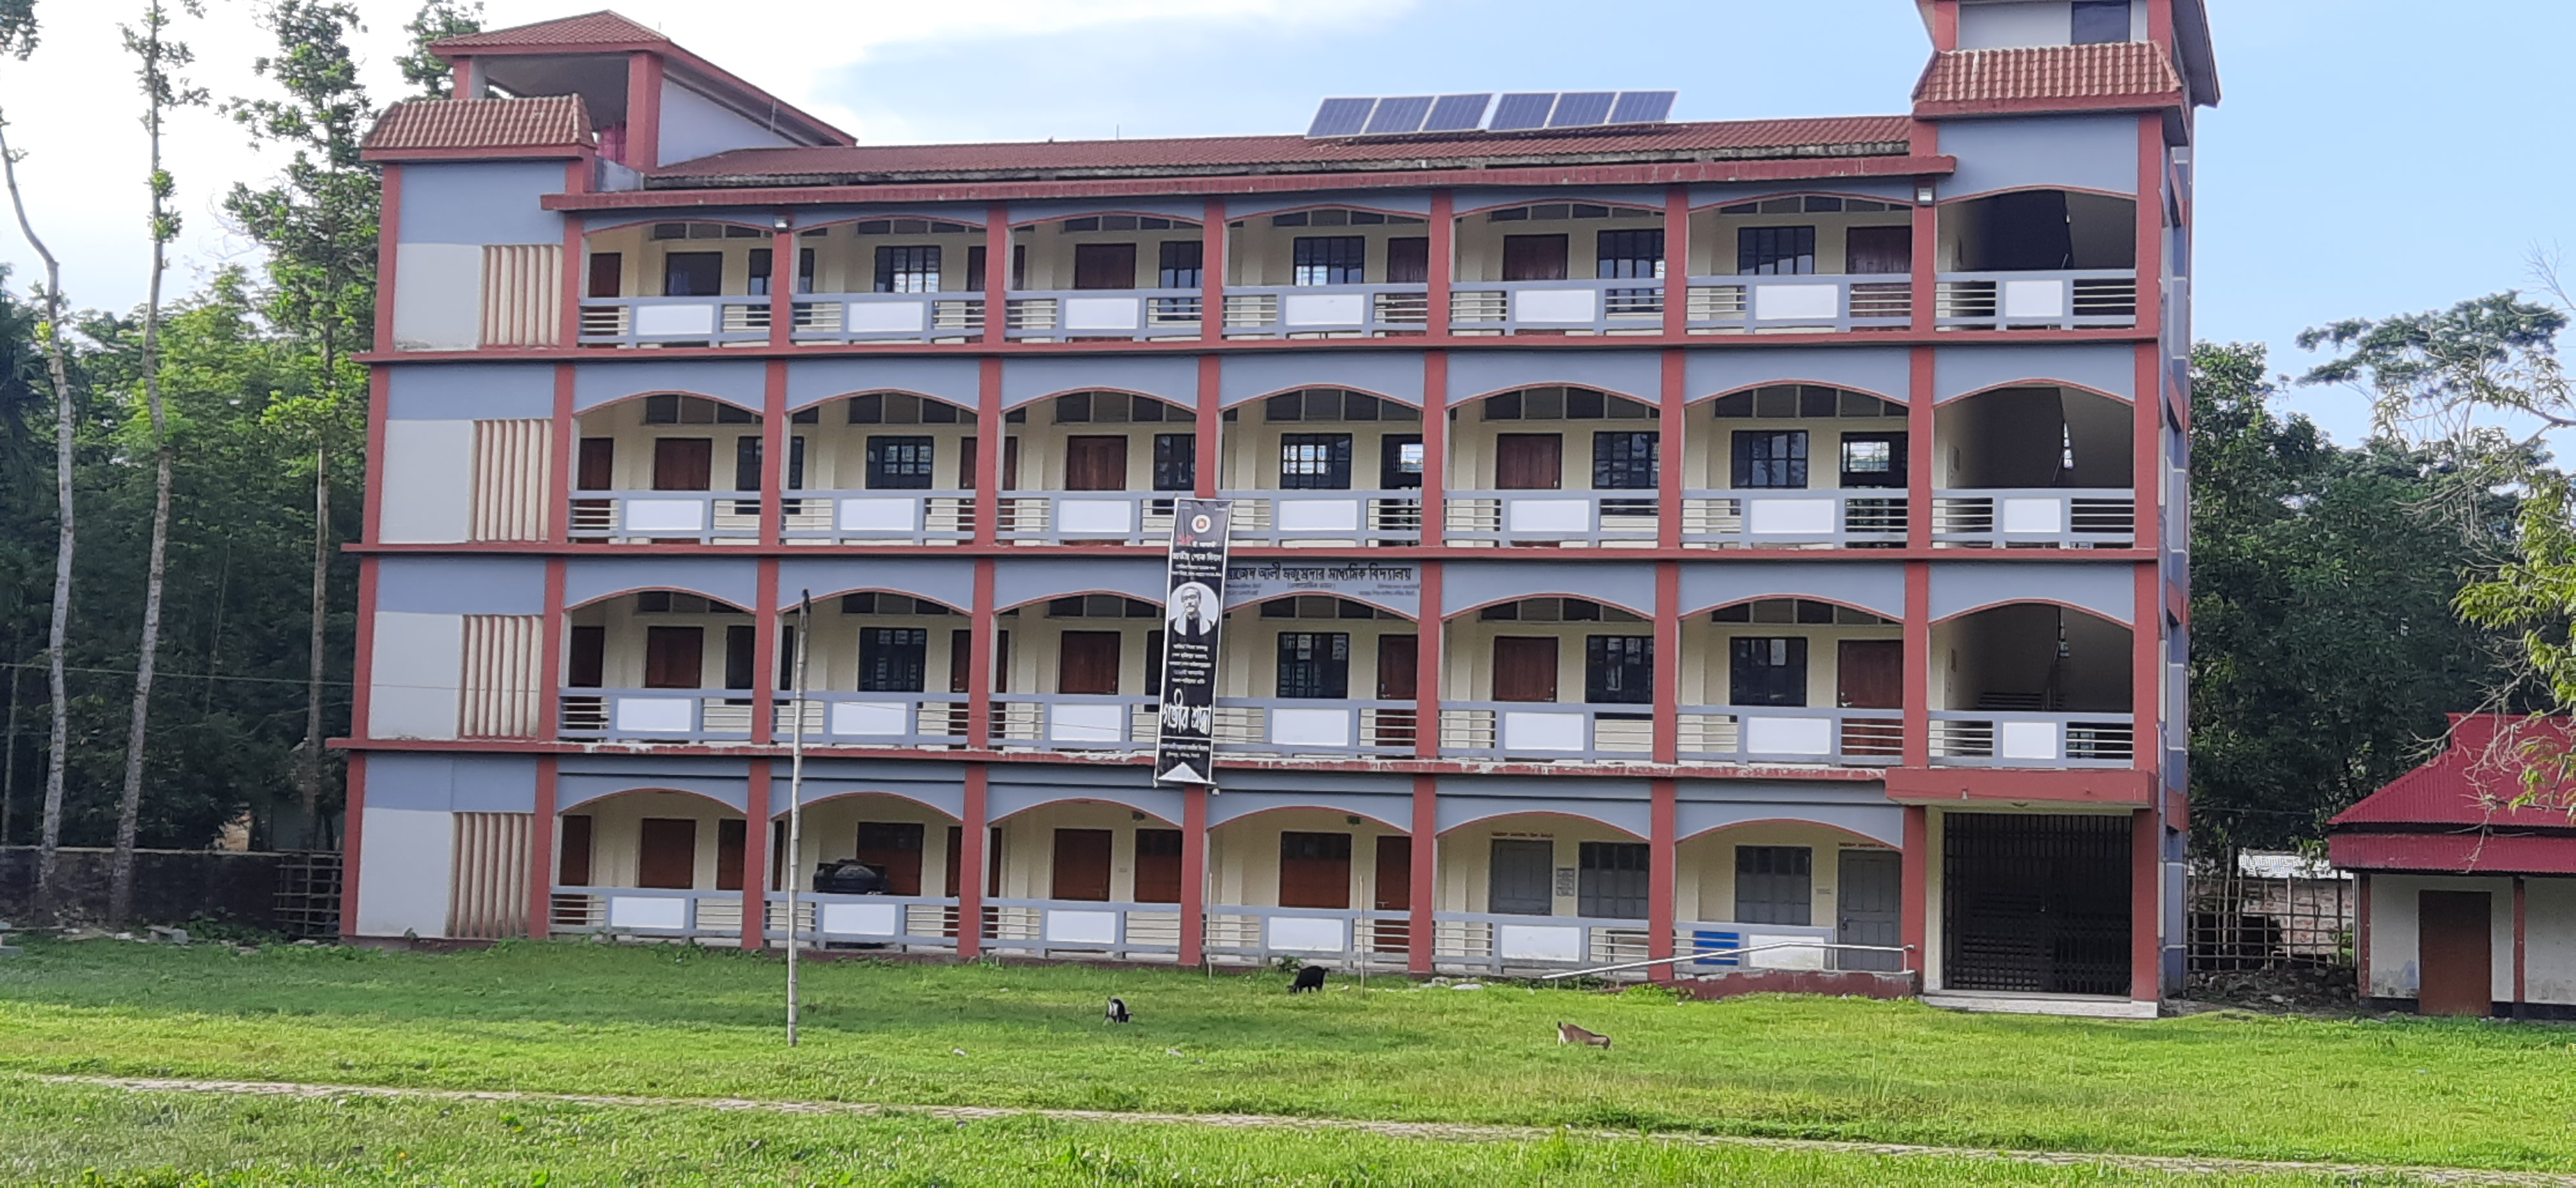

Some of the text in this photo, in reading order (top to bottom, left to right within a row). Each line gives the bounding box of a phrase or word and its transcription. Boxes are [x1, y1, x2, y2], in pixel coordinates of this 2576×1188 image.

[1259, 562, 1281, 580] আলী
[1329, 562, 1367, 581] মাধ্যমিক
[1368, 562, 1412, 581] বিদ্যালয়
[1162, 687, 1189, 734] গভীর
